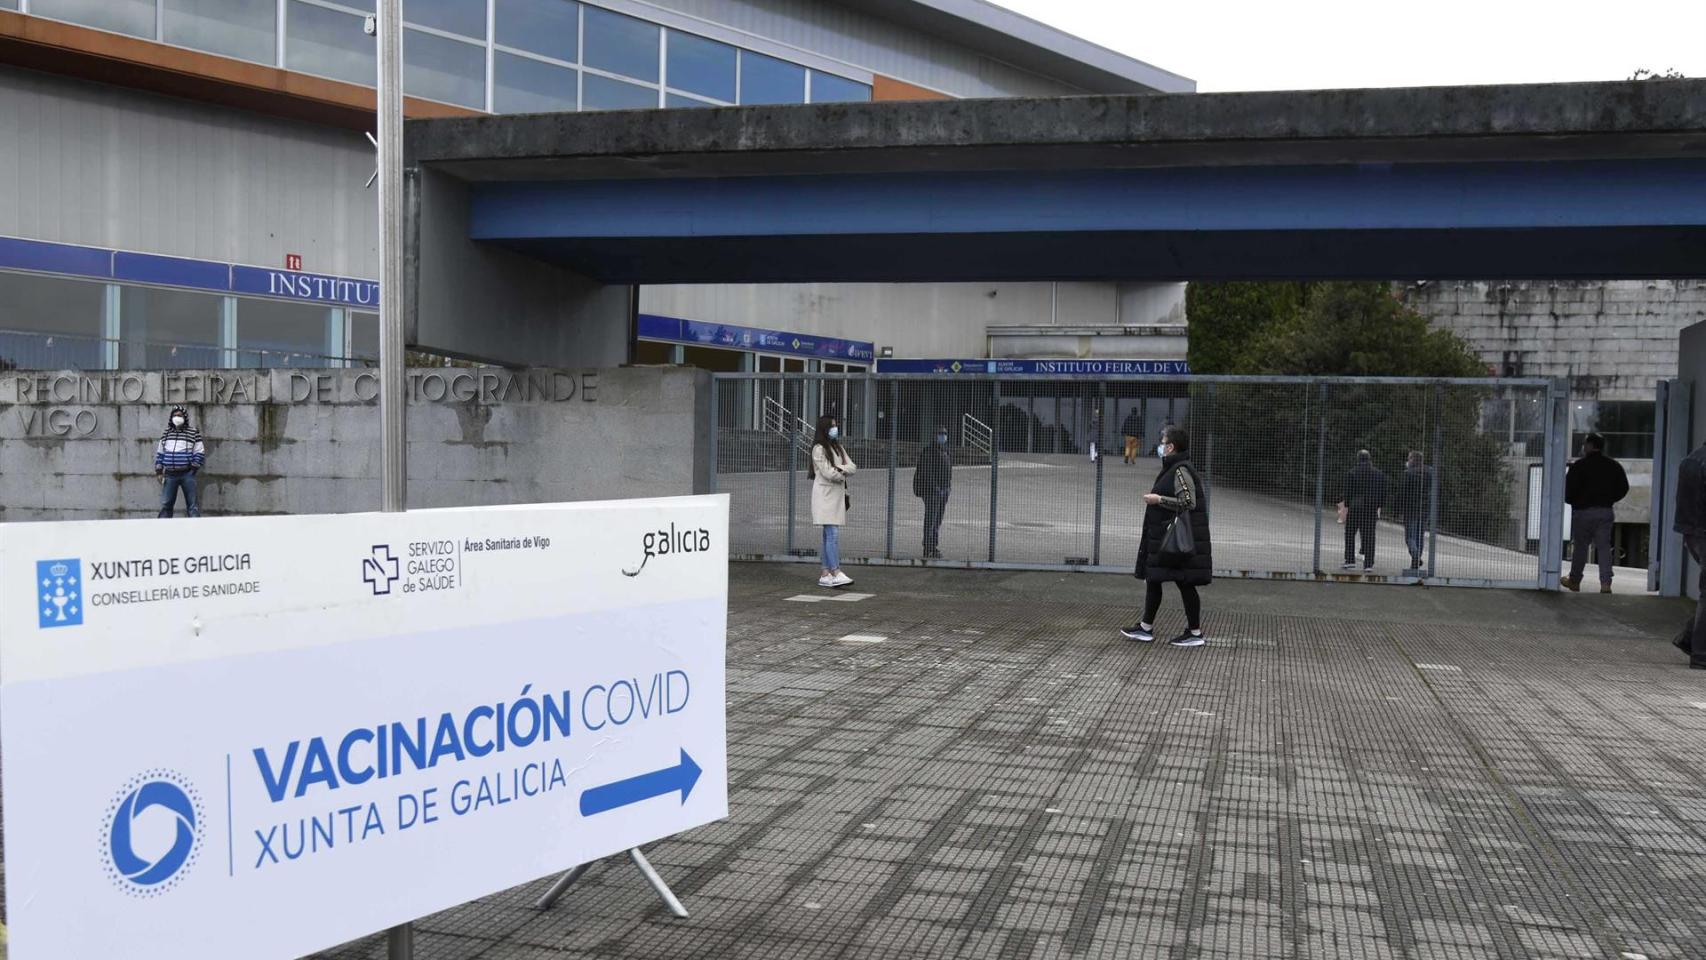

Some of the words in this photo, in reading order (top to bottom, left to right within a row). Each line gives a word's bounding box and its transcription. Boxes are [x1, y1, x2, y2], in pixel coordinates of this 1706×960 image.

[1035, 361, 1102, 373] INSTITUTO
[1105, 362, 1150, 373] FEIRAL
[1153, 362, 1171, 373] DE
[15, 374, 145, 402] RECINTO
[163, 373, 272, 402] FEIRAL
[290, 374, 332, 402] DE
[354, 372, 598, 402] CTOGRANDE
[18, 408, 98, 436] VIGO
[408, 540, 454, 557] SERVIZO
[464, 536, 484, 552] Área
[485, 536, 521, 551] Sanitaria
[522, 536, 532, 549] de
[533, 535, 550, 551] Vigo
[91, 560, 153, 580] XUNTA
[159, 558, 180, 576] DE
[184, 553, 252, 573] GALICIA
[407, 558, 455, 575] GALEGO
[92, 587, 181, 607] CONSELLERÍA
[182, 586, 199, 599] DE
[202, 581, 261, 596] SANIDADE
[402, 577, 416, 593] de
[418, 573, 455, 592] SAÚDE
[253, 684, 571, 803] VACINACIÓN
[581, 669, 690, 731] COVID
[255, 801, 385, 868] XUNTA
[398, 787, 439, 830] DE
[450, 757, 566, 817] GALICIA
